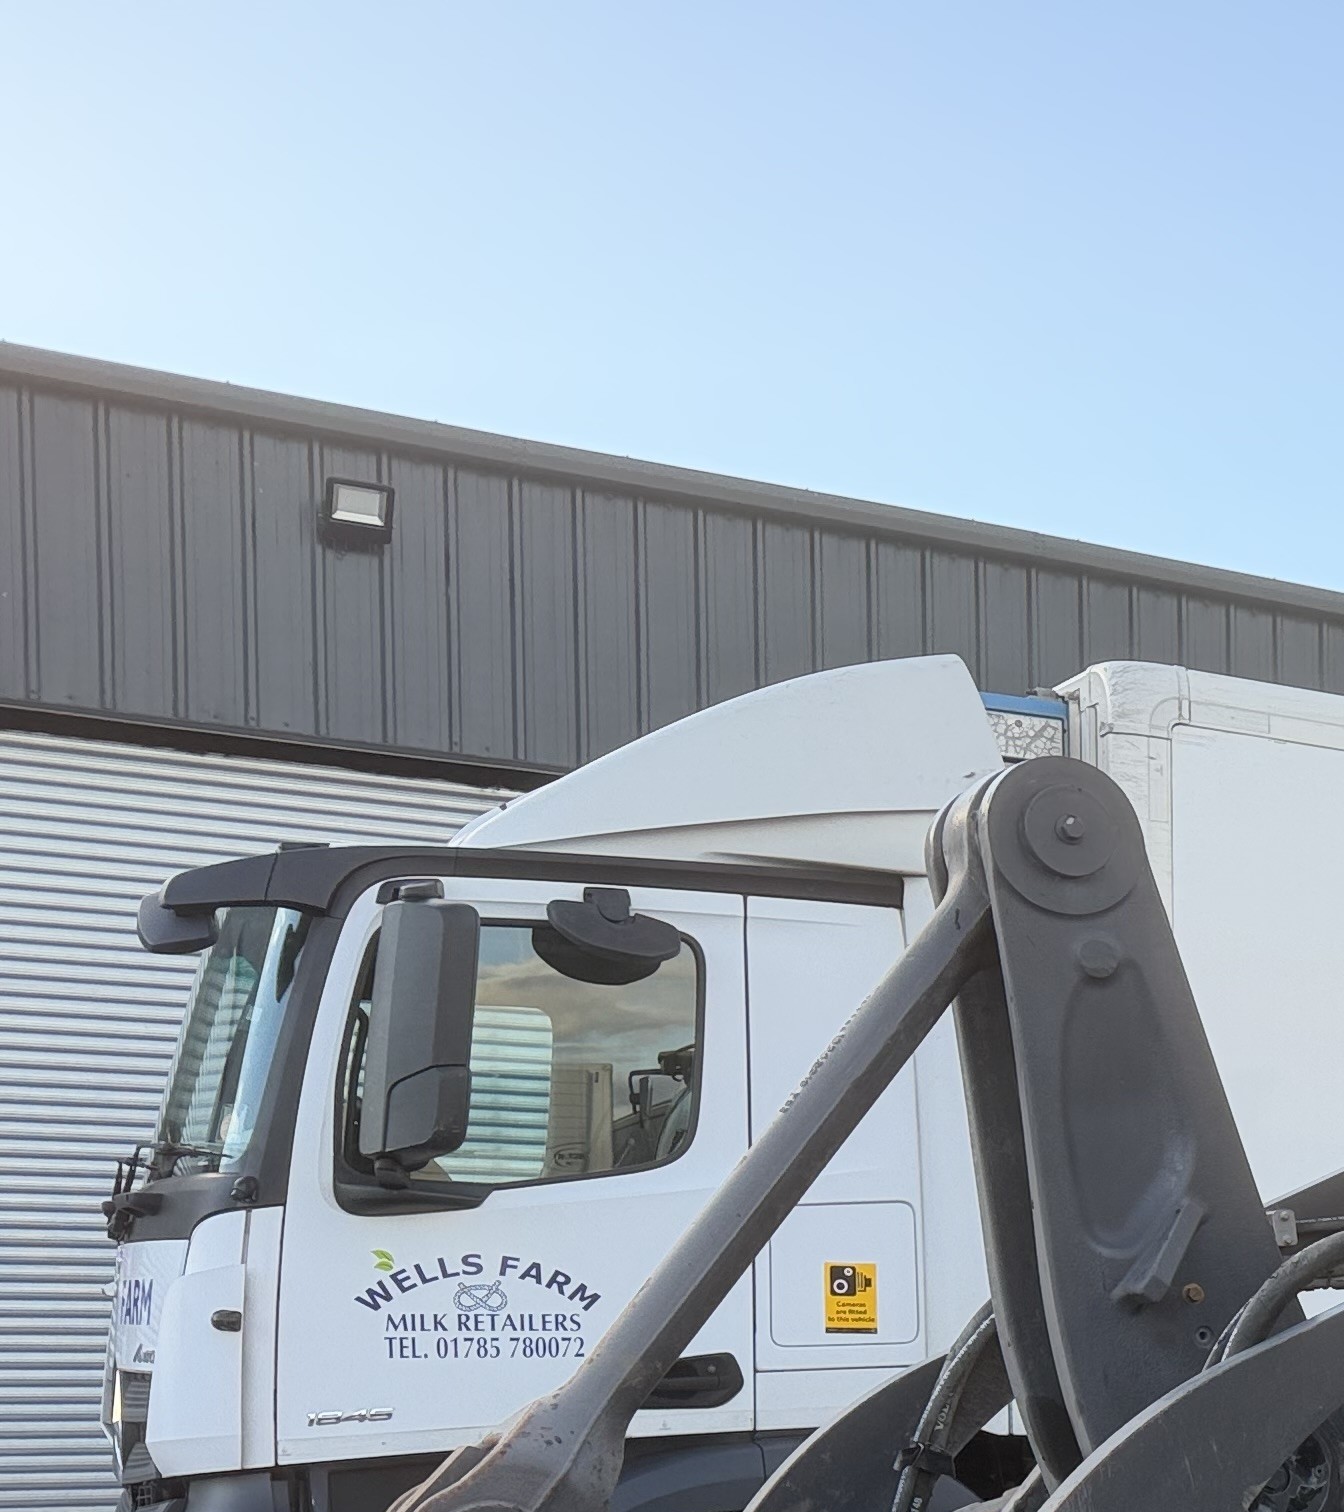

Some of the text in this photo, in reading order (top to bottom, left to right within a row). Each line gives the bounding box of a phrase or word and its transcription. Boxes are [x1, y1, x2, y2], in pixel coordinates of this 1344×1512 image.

[354, 1253, 602, 1312] WELLS FARM
[385, 1313, 582, 1332] MILK RETAILERS
[384, 1336, 585, 1359] TEL. 01785 780072
